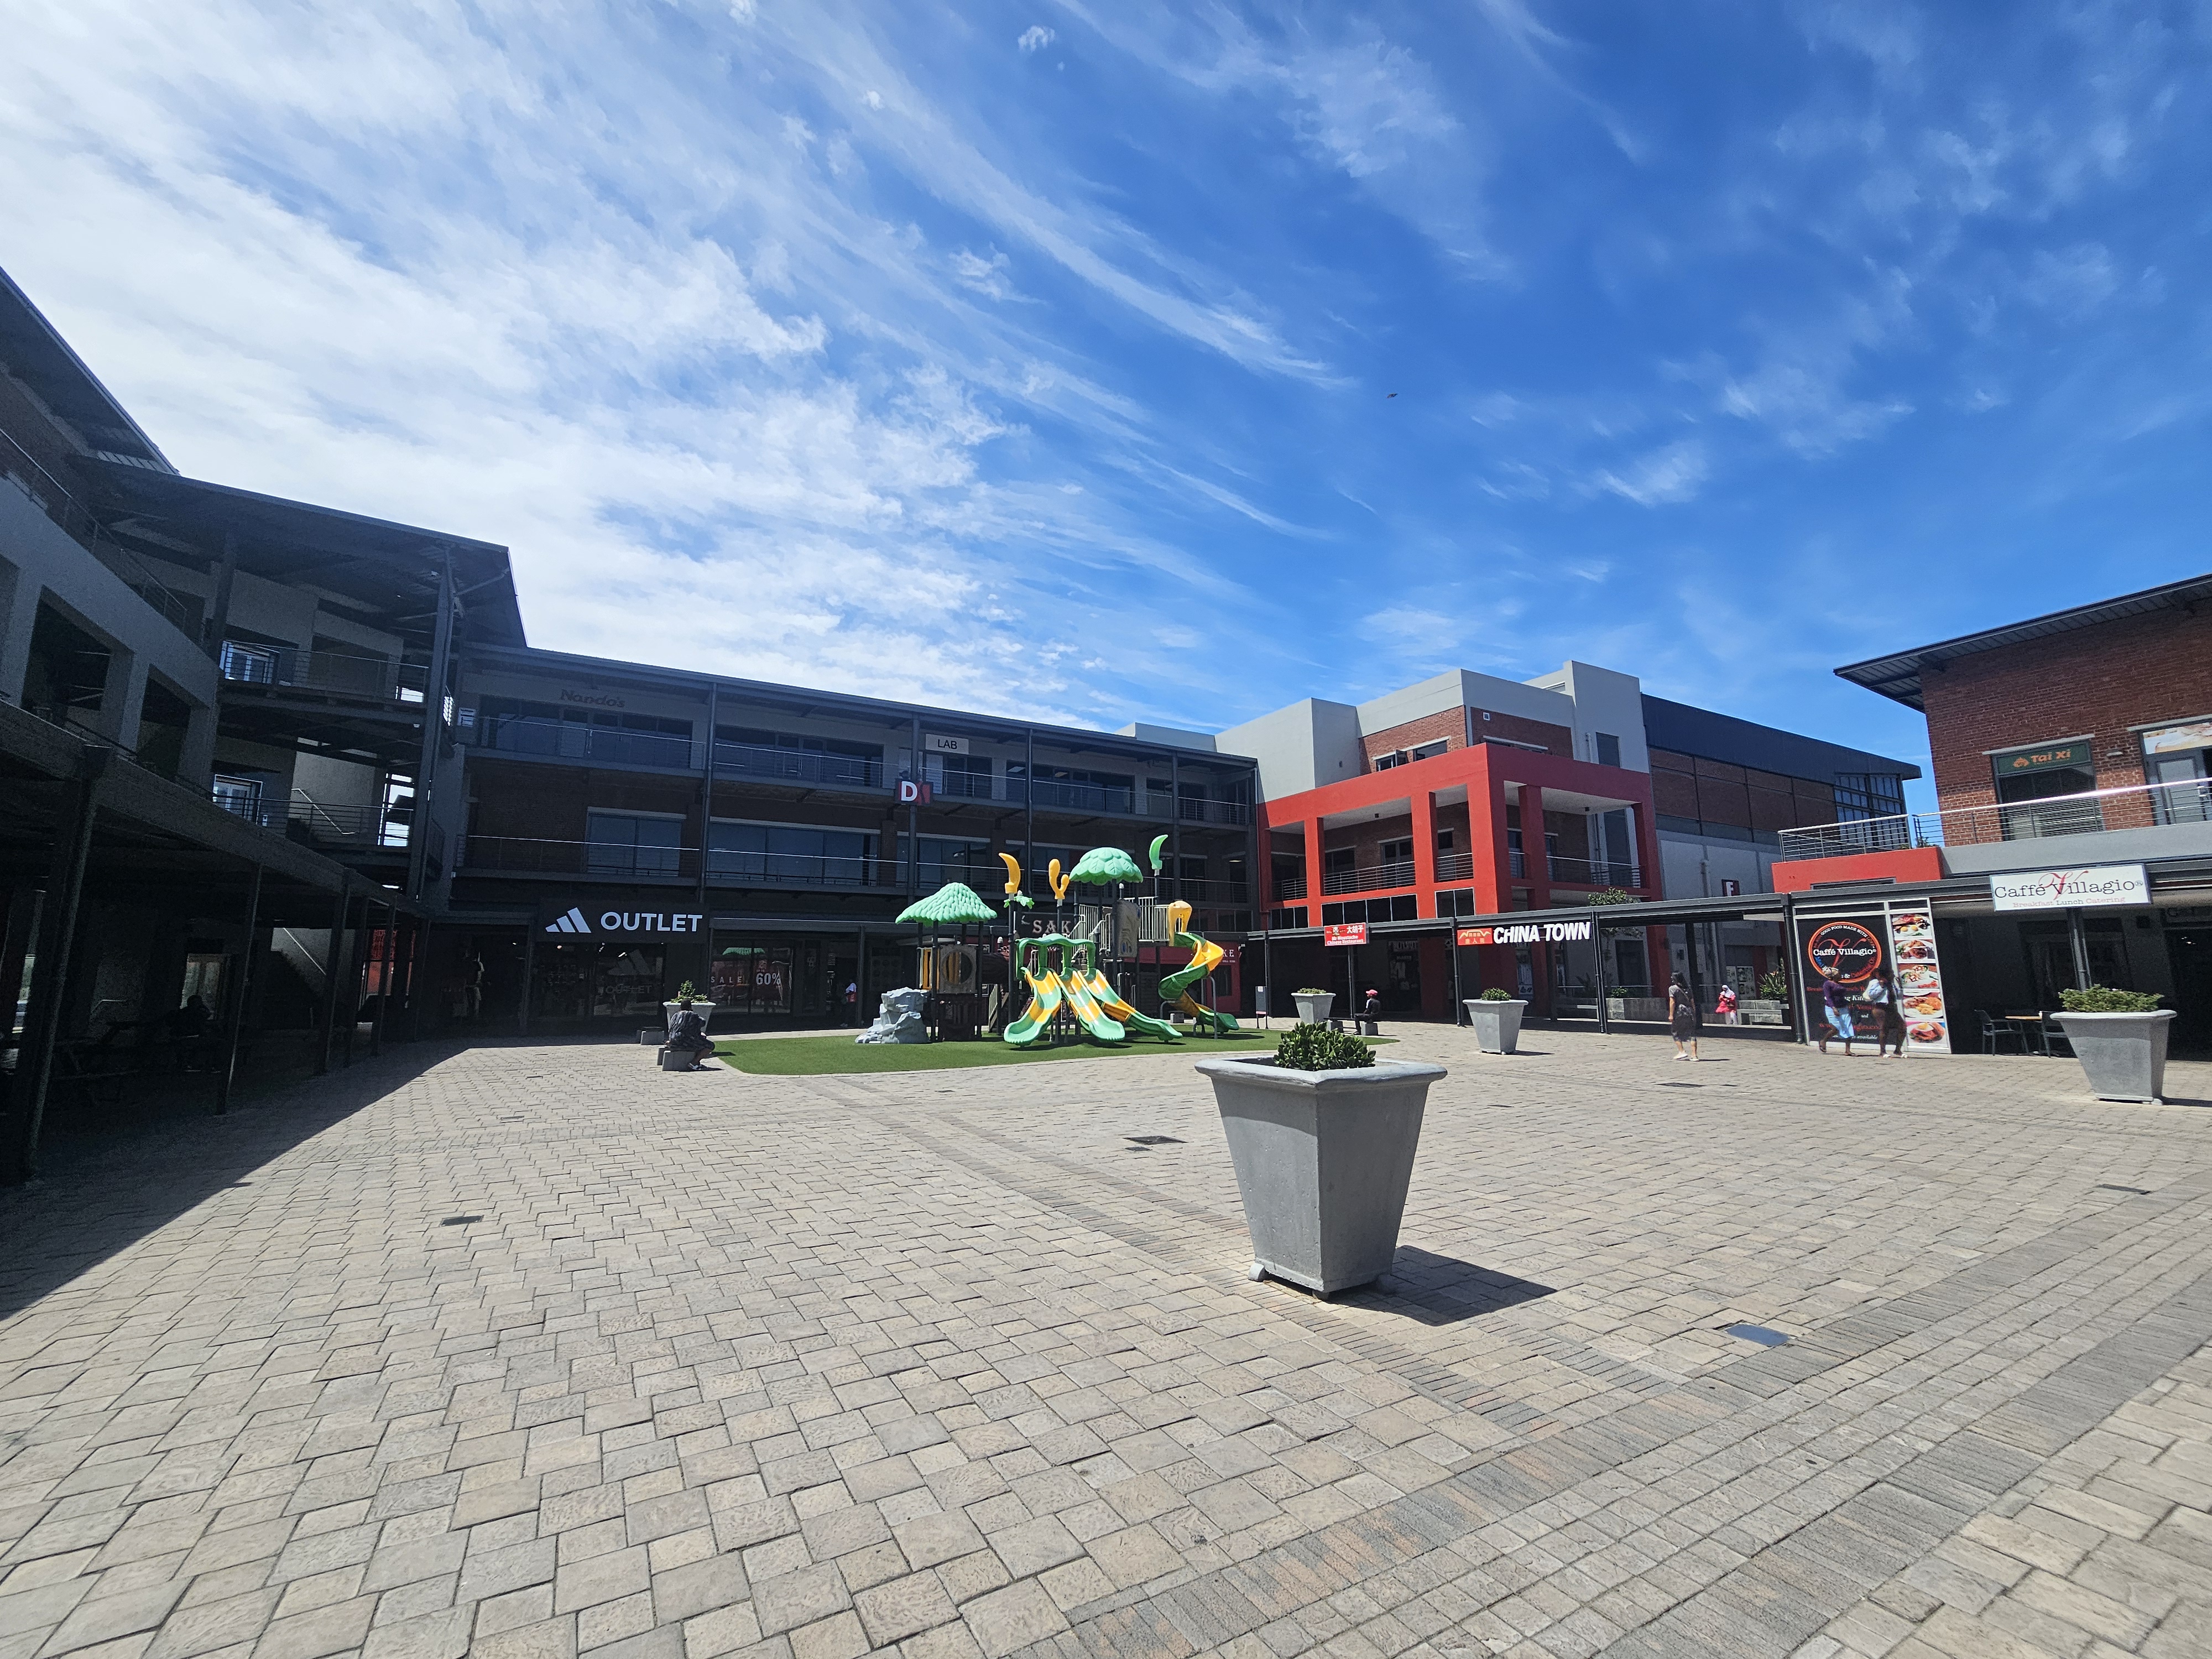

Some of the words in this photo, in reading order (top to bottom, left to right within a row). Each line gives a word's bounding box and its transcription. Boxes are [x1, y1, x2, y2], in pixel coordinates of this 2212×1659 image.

[559, 688, 626, 708] Nando's
[937, 739, 957, 749] LAB
[2030, 752, 2052, 763] Tai
[2056, 749, 2072, 759] Xi
[900, 781, 918, 802] D
[1725, 881, 1734, 896] F
[1994, 884, 2046, 899] Caffé
[2086, 896, 2126, 904] Catering
[600, 911, 703, 932] OUTLET
[1032, 920, 1072, 933] SAK
[1493, 925, 1540, 944] CHINA
[1543, 921, 1591, 942] TOWN
[1820, 927, 1832, 936] GOOD
[1856, 929, 1868, 938] WITH
[755, 973, 781, 985] 60%
